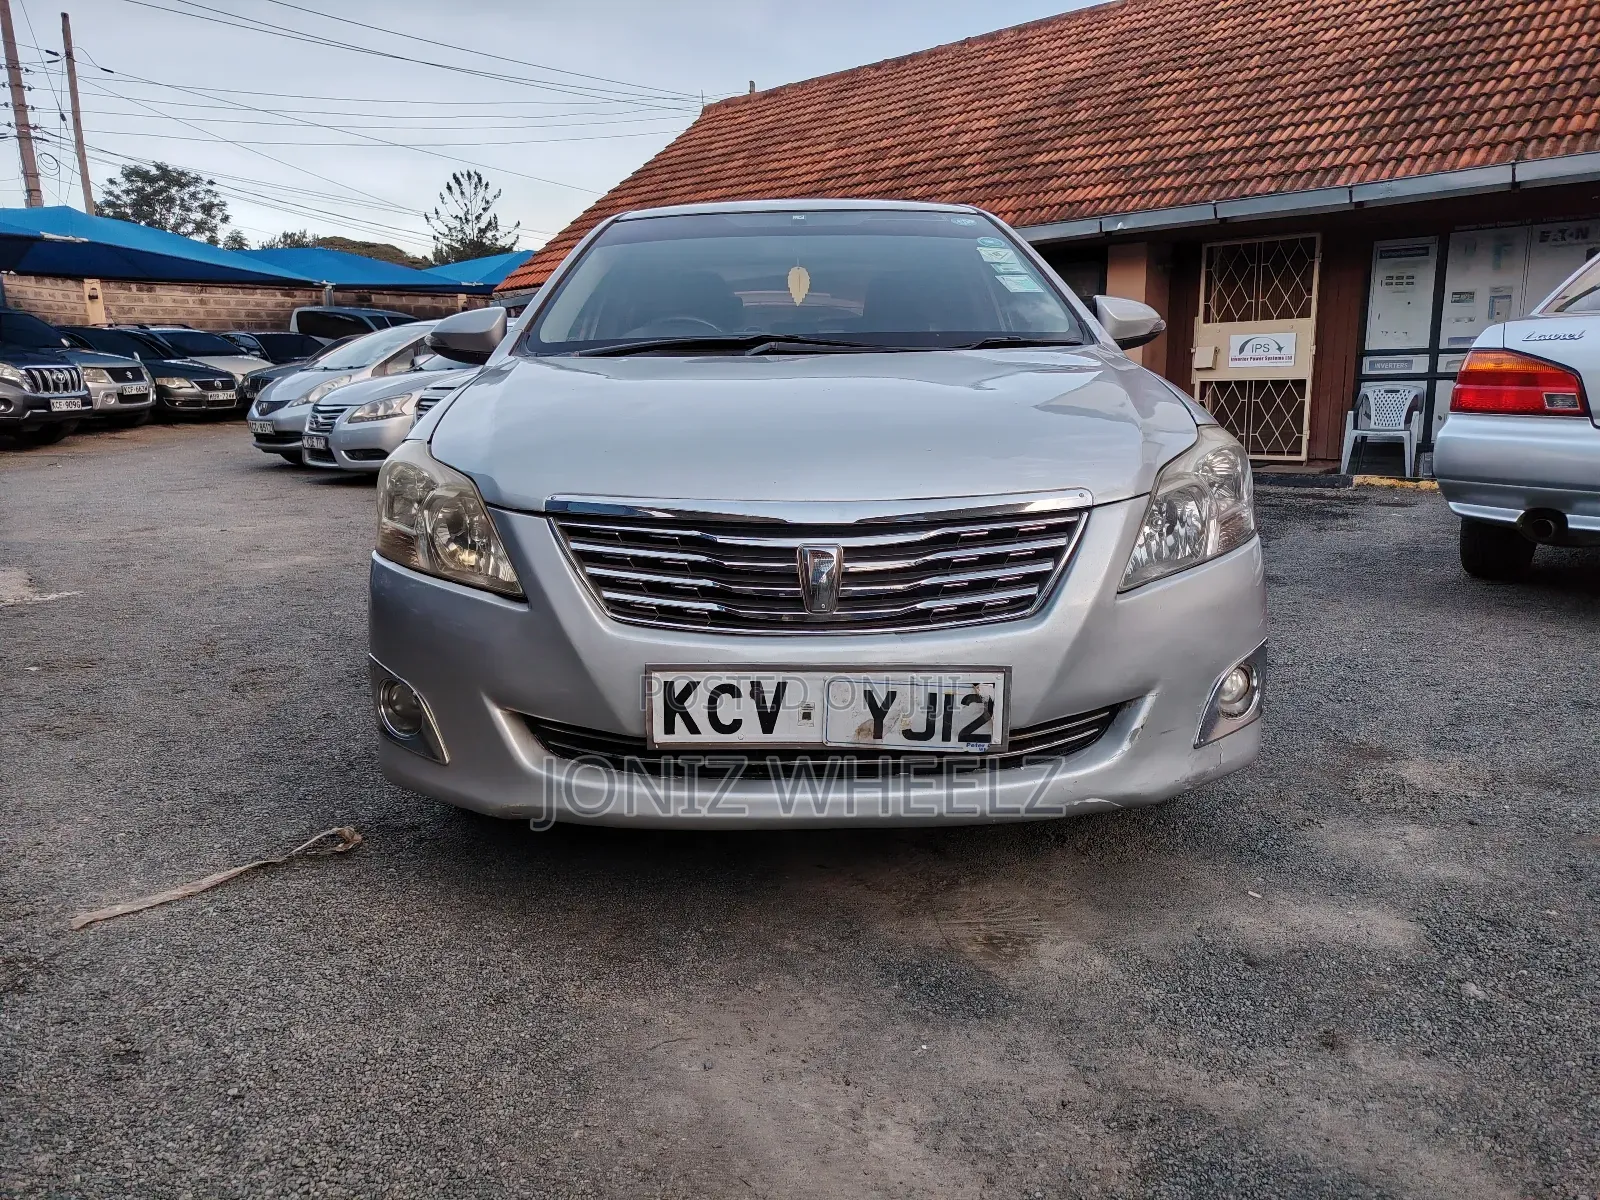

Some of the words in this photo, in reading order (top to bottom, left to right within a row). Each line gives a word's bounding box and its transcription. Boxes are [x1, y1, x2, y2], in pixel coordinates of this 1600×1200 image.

[1521, 330, 1586, 342] Laurel
[1251, 343, 1270, 353] IPS
[663, 680, 789, 735] KCV
